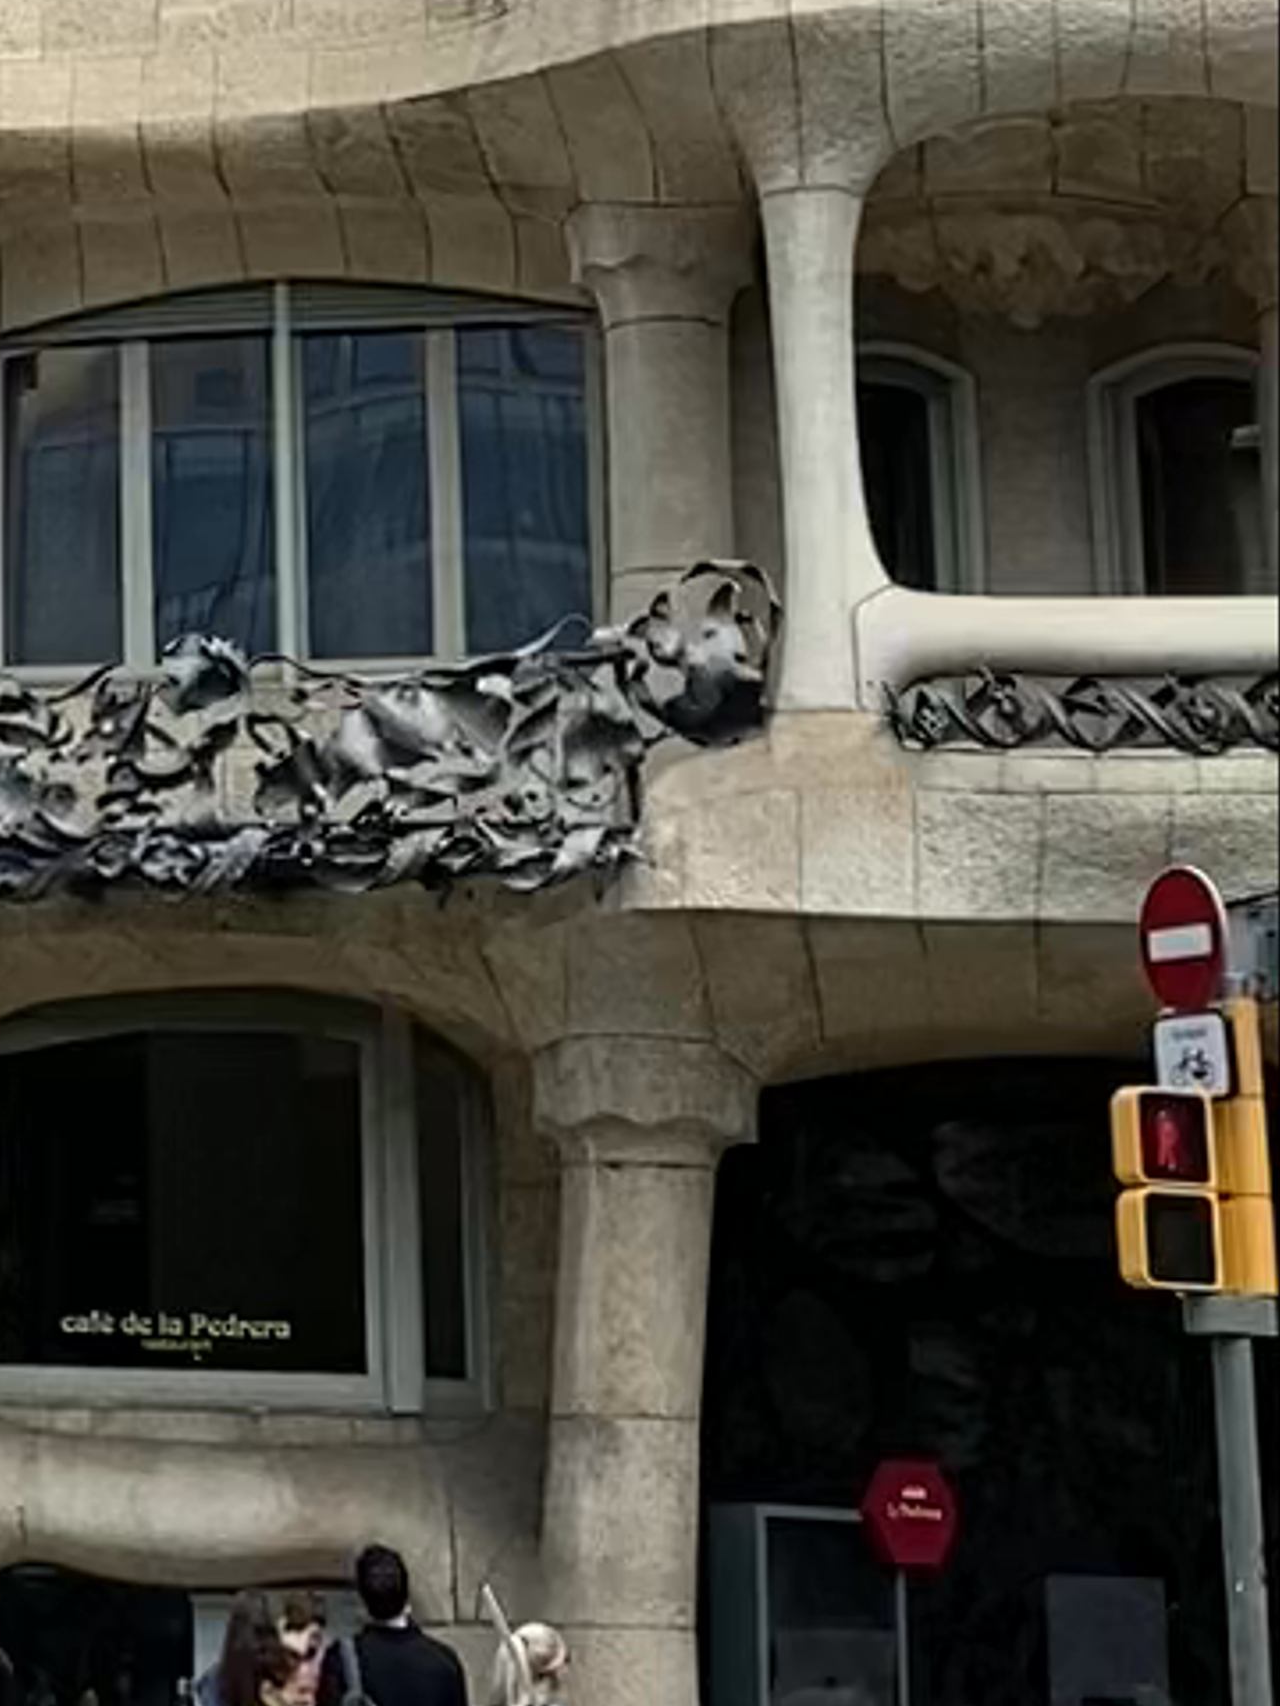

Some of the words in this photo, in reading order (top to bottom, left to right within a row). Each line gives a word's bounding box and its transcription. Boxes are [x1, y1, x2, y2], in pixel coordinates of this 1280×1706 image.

[119, 1311, 153, 1335] de
[158, 1312, 184, 1336] la
[190, 1313, 291, 1339] Pedrera
